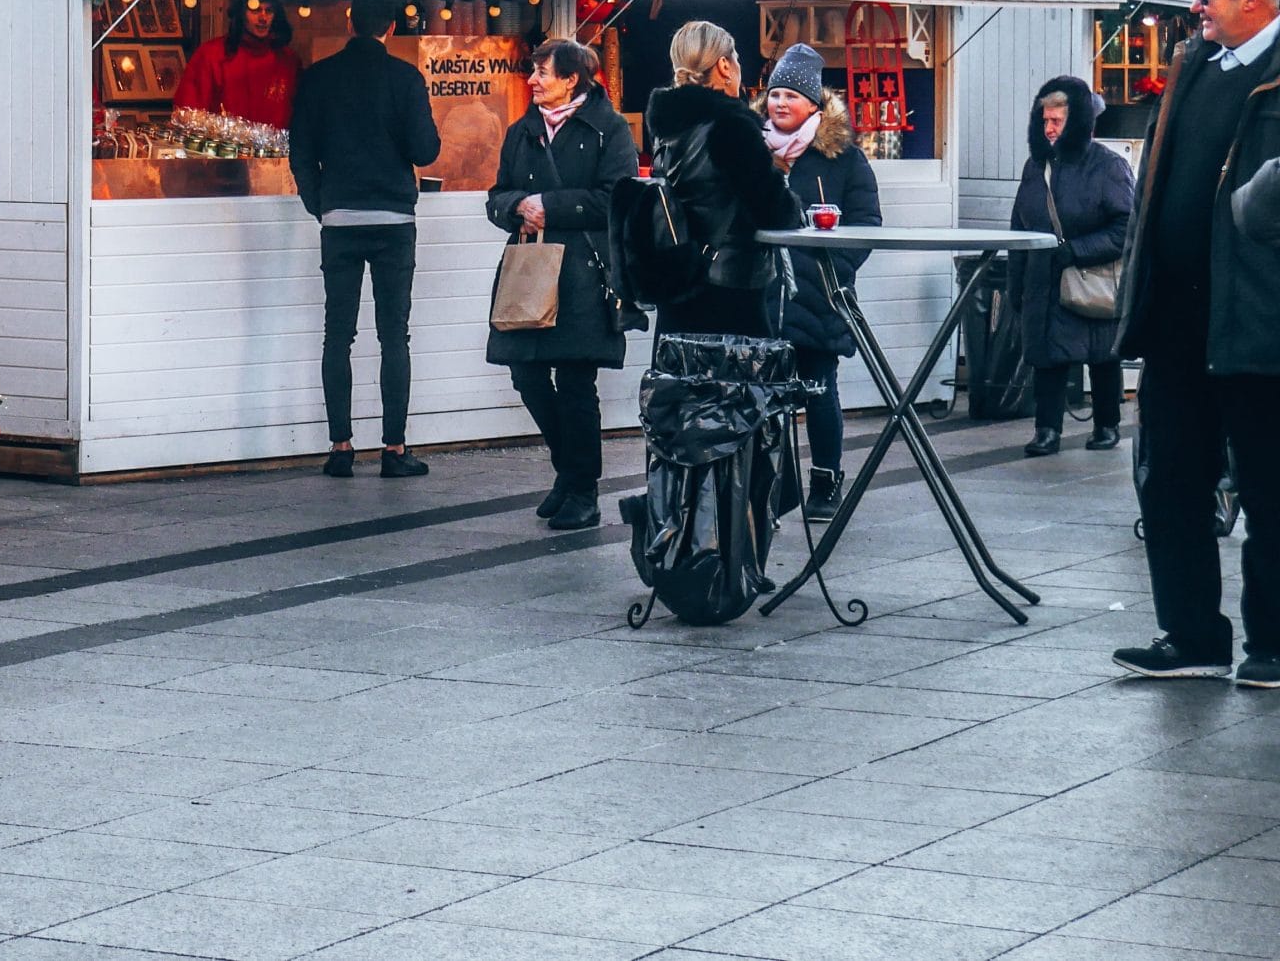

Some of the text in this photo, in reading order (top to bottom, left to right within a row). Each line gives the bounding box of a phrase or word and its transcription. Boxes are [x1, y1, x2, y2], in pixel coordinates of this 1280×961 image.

[431, 54, 525, 74] KARŠTAS VYNA
[431, 81, 491, 96] DESERTAI
